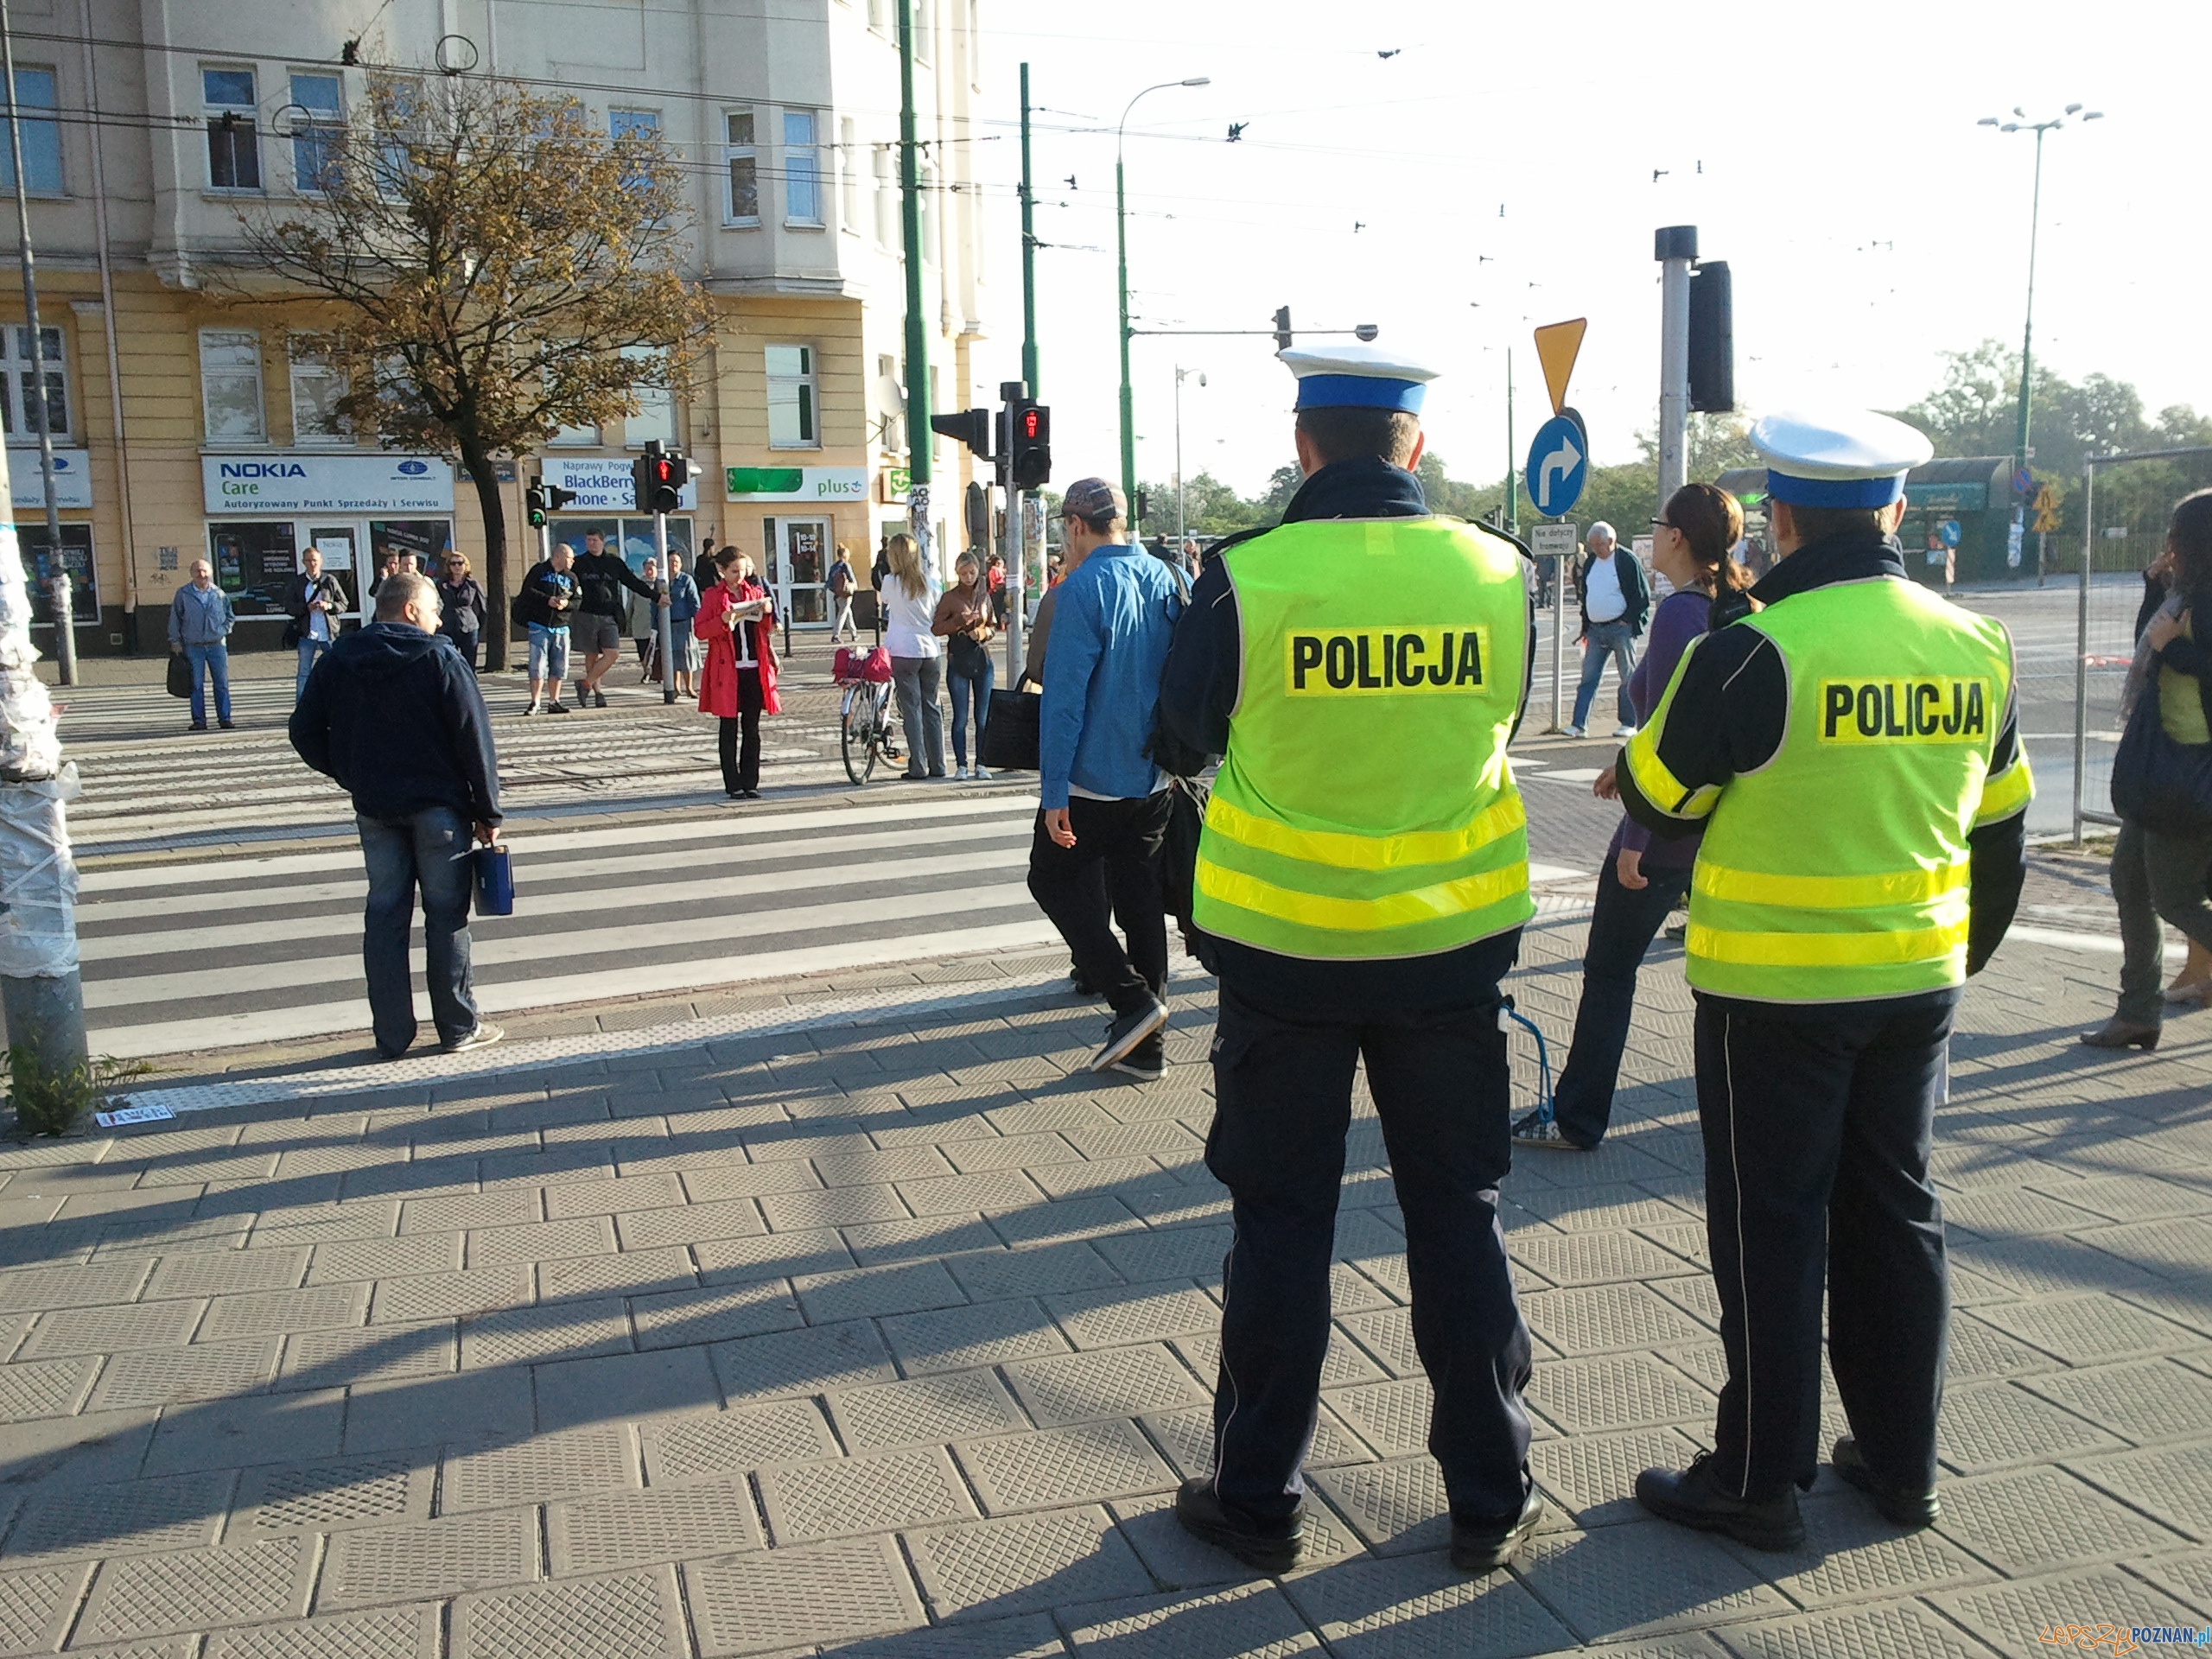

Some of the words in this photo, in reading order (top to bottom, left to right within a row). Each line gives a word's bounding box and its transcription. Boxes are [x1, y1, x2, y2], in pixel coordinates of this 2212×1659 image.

[220, 463, 306, 477] NOKIA
[563, 461, 603, 472] Naprawy
[221, 480, 259, 495] Care
[817, 479, 850, 497] plus
[224, 499, 299, 510] Autoryzowany
[303, 499, 334, 508] Punkt
[338, 499, 388, 508] Sprzedaży
[400, 499, 439, 508] Serwisu
[1293, 632, 1483, 690] POLICJA
[1825, 682, 1984, 738] POLICJA
